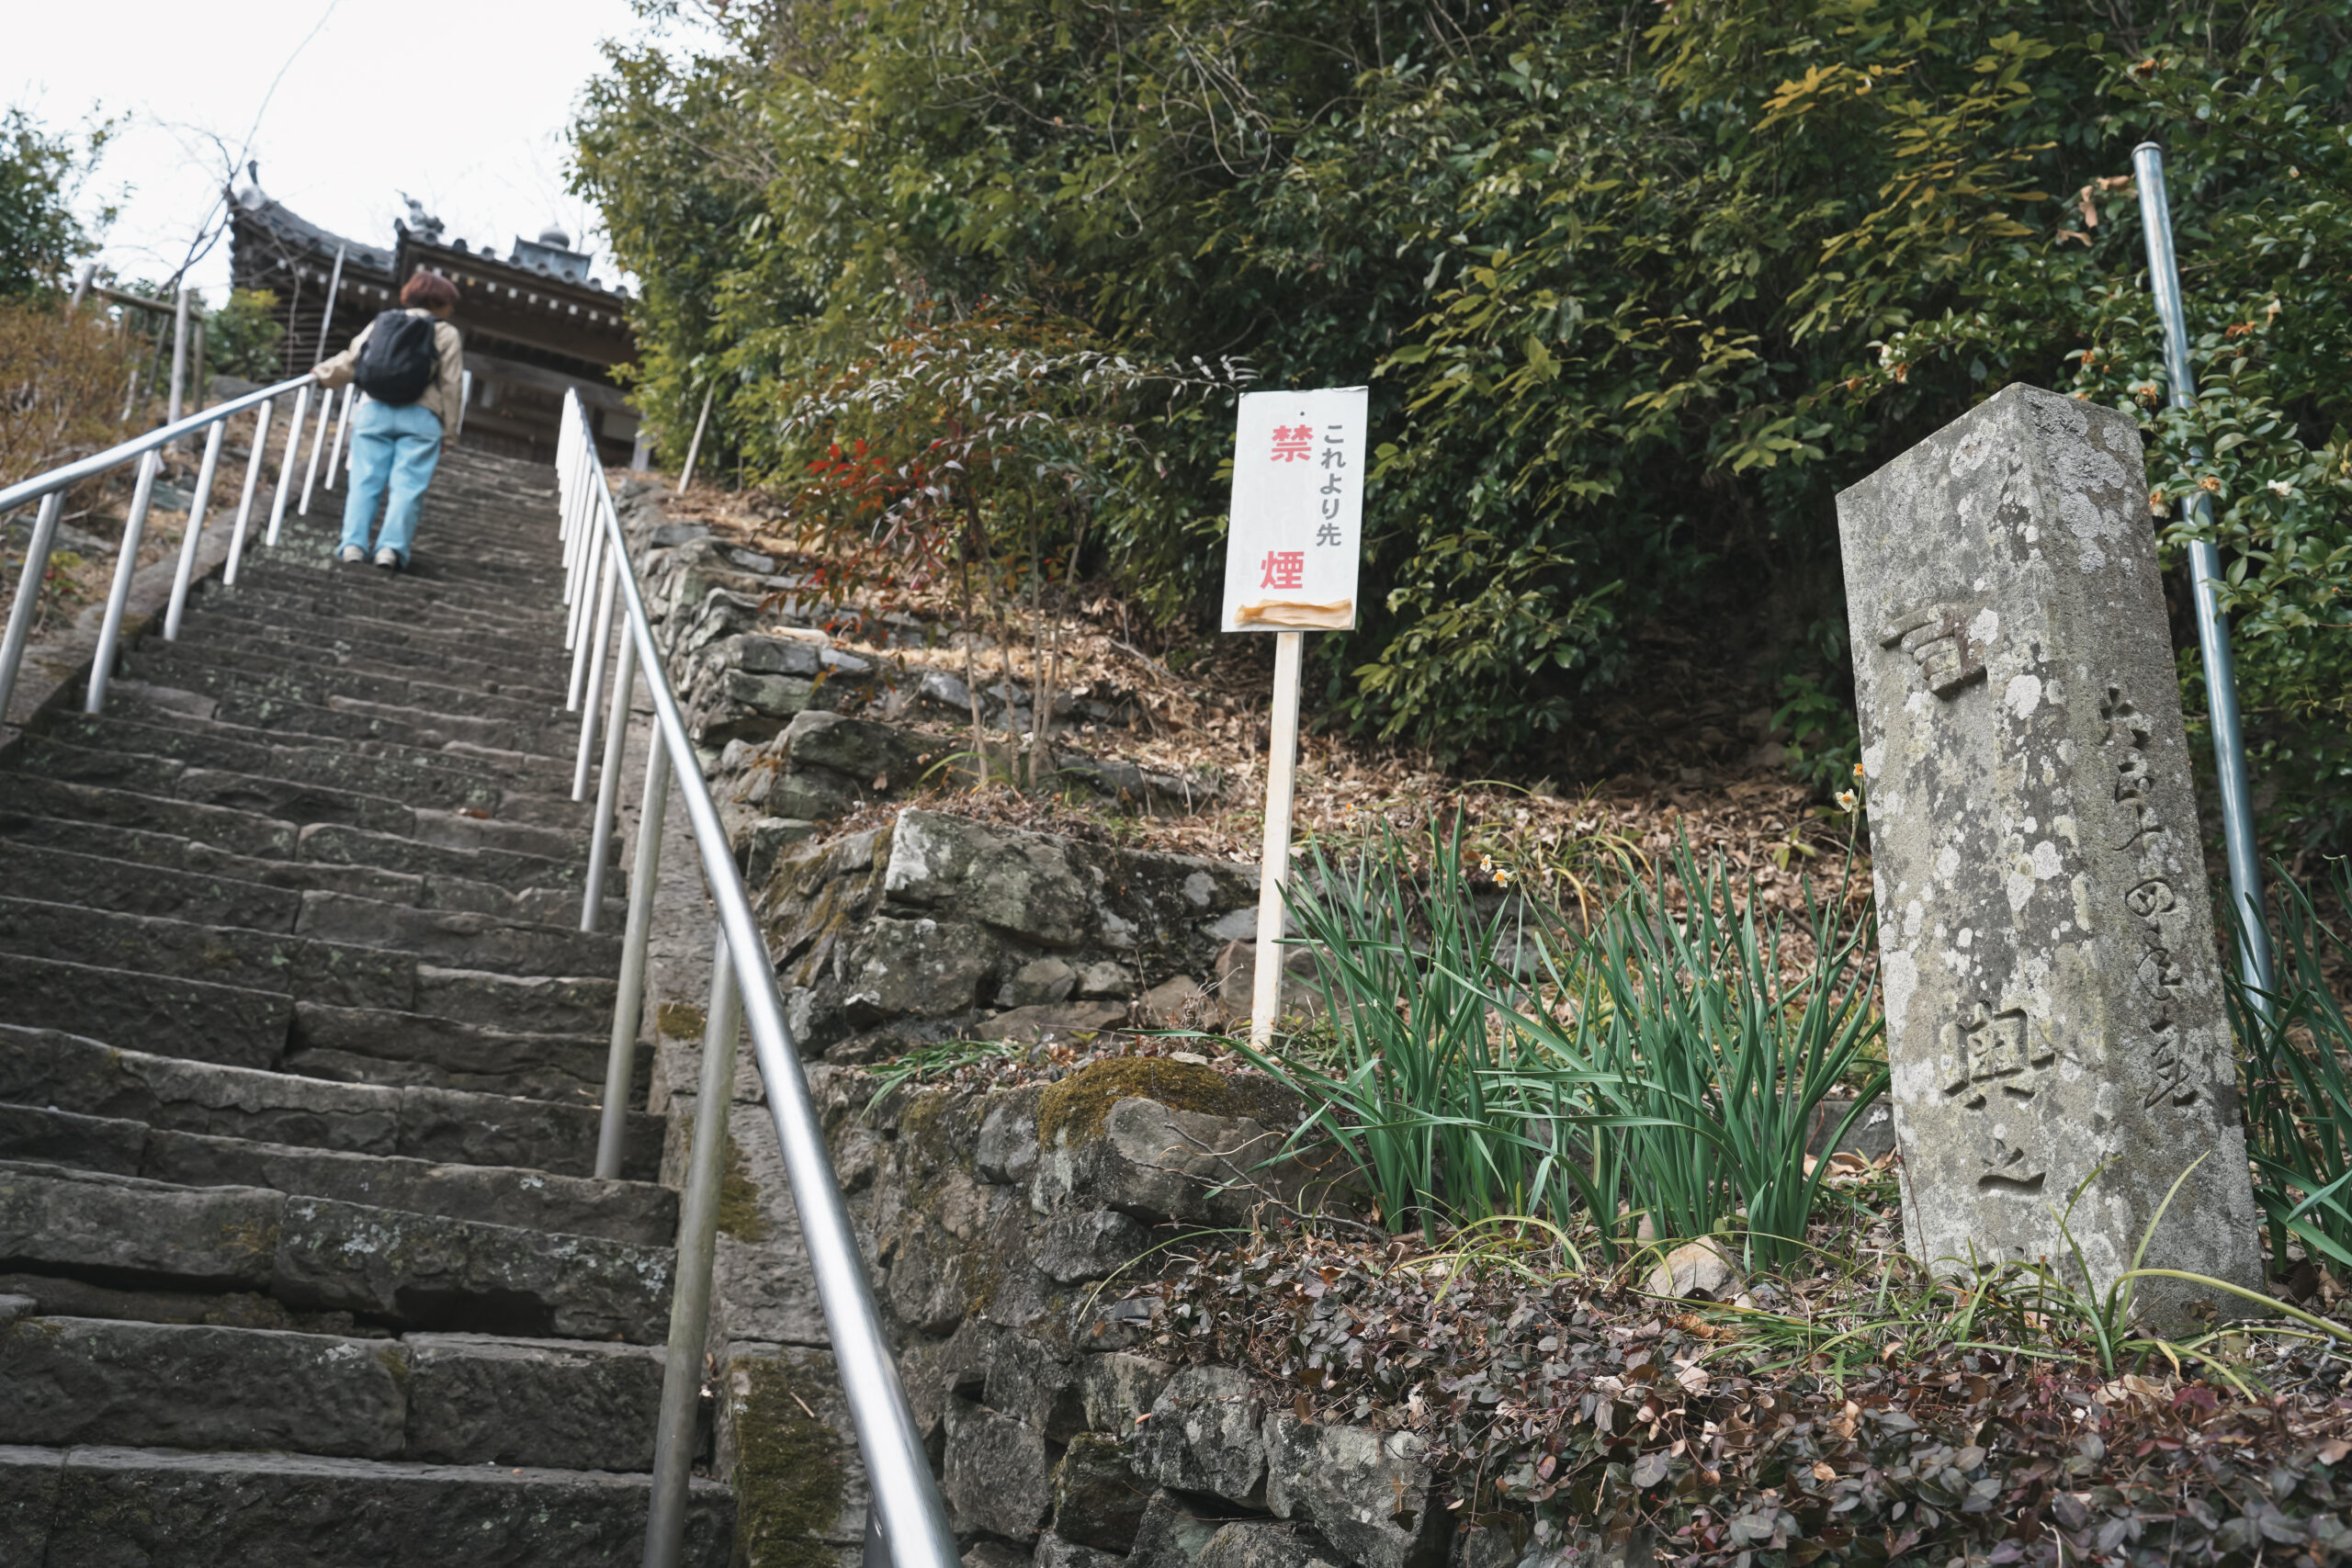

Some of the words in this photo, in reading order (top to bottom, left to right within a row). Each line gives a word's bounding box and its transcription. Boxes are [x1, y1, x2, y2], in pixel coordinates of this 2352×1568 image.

[1260, 424, 1314, 590] 禁煙
[1316, 424, 1347, 547] これより先
